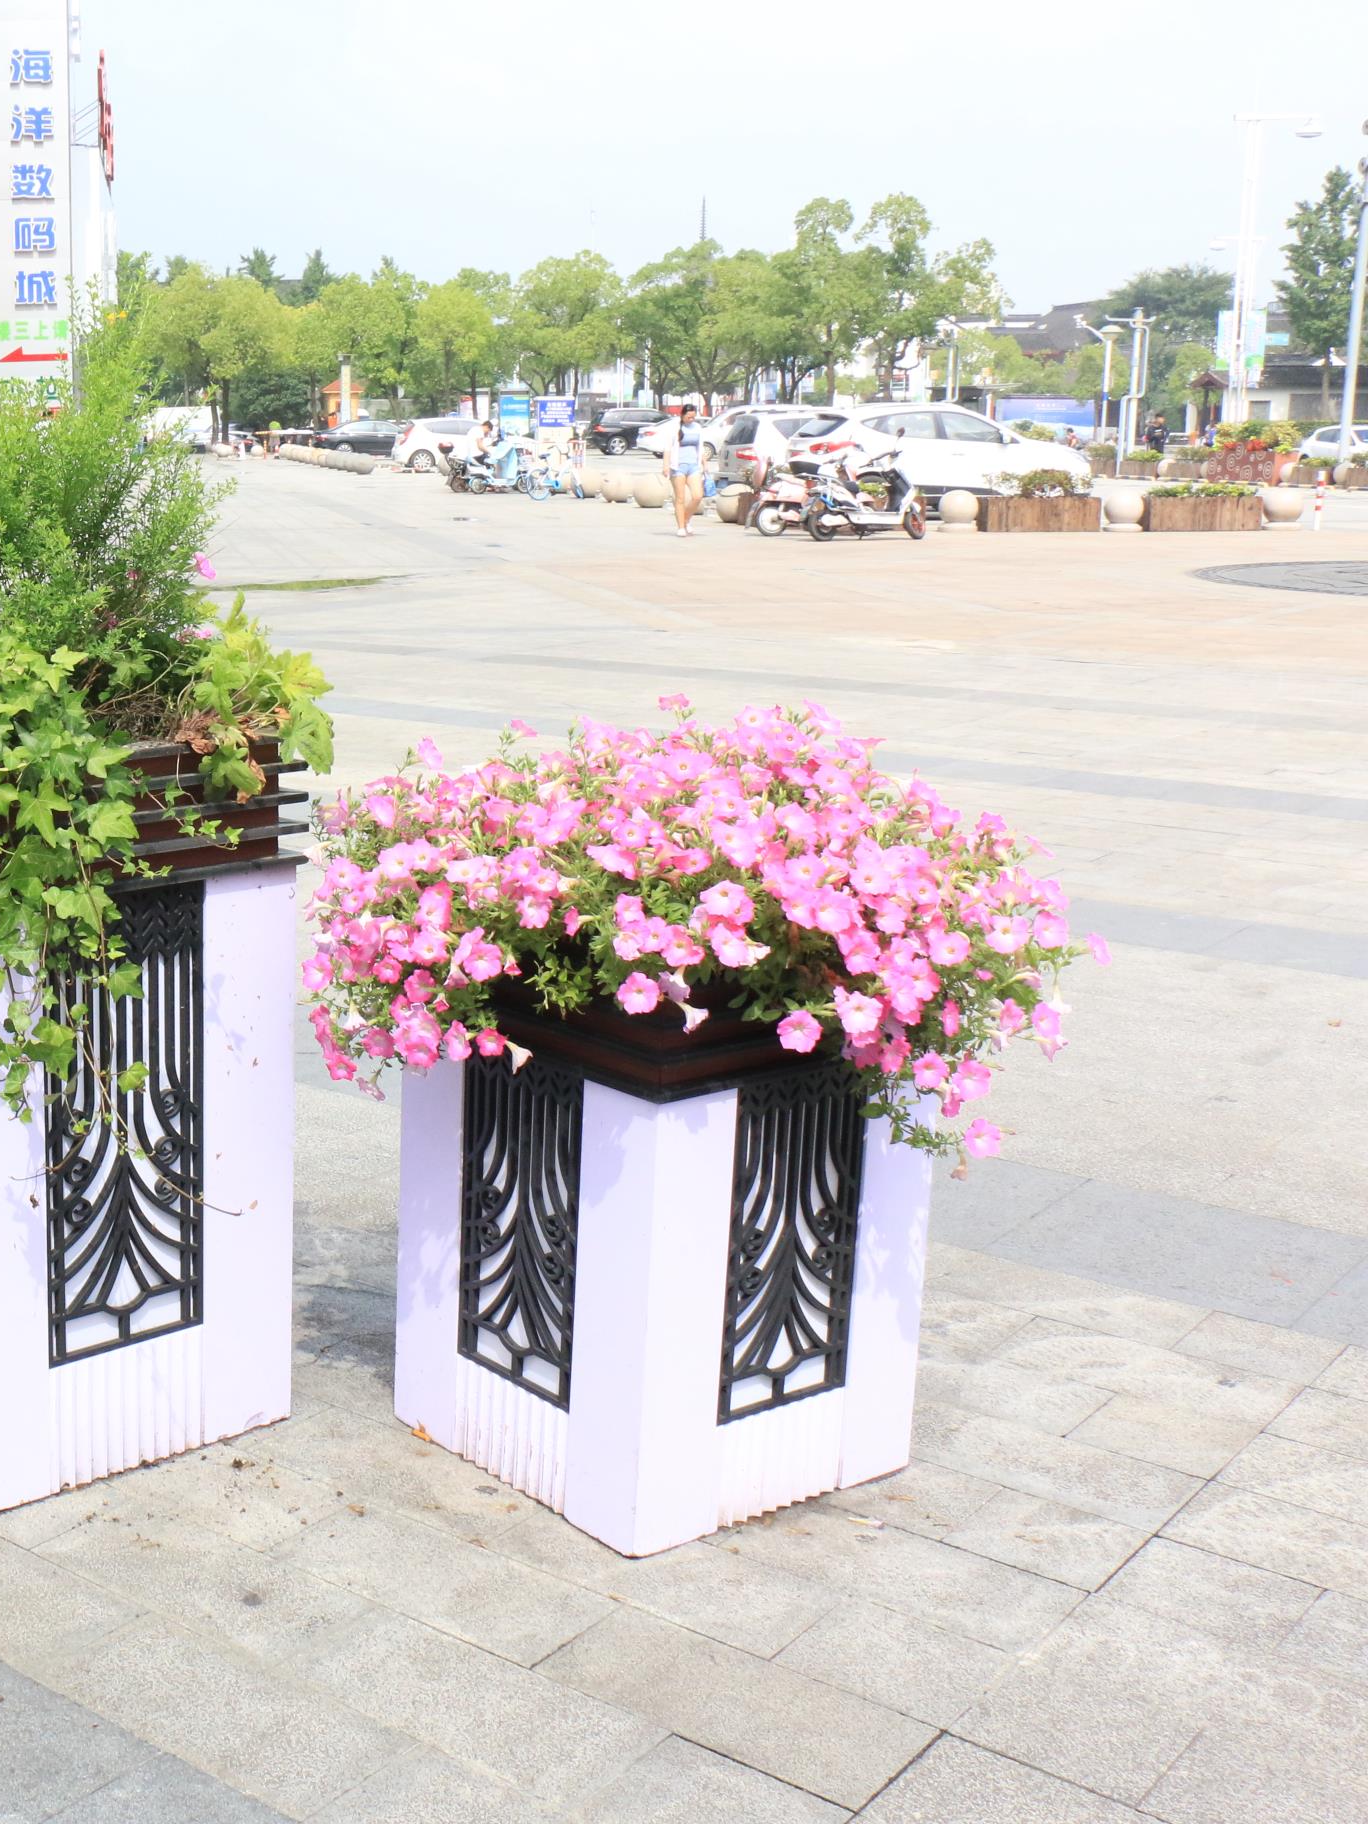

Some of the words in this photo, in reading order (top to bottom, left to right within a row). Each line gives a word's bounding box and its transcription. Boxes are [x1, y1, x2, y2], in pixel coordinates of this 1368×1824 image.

[10, 48, 57, 307] 海洋数码城
